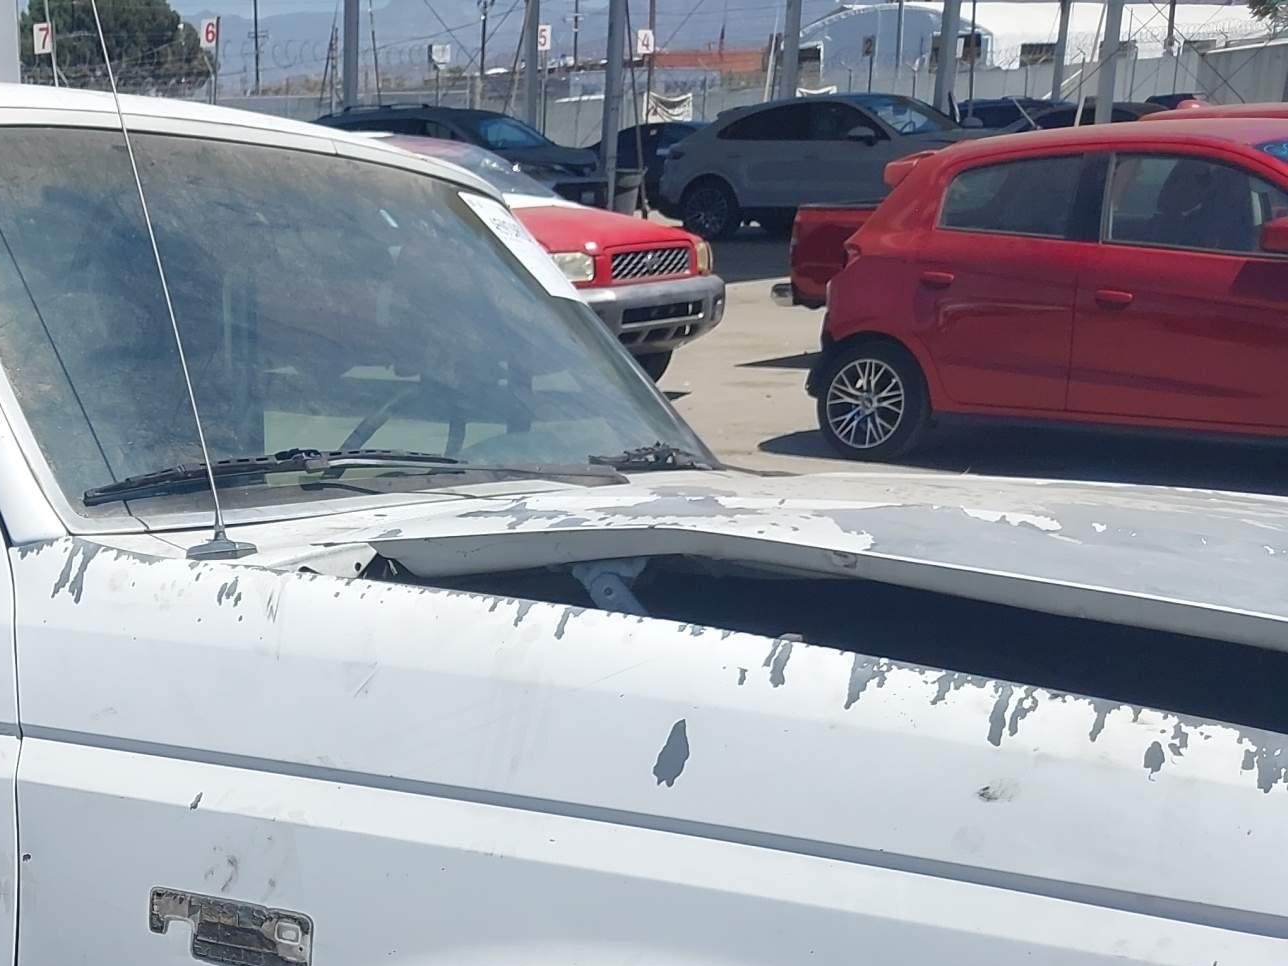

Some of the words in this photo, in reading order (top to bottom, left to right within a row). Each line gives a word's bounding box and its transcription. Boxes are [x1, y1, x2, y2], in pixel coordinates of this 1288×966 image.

[38, 27, 50, 50] 7
[205, 22, 216, 43] 6
[539, 28, 547, 47] 5
[642, 33, 650, 50] 4
